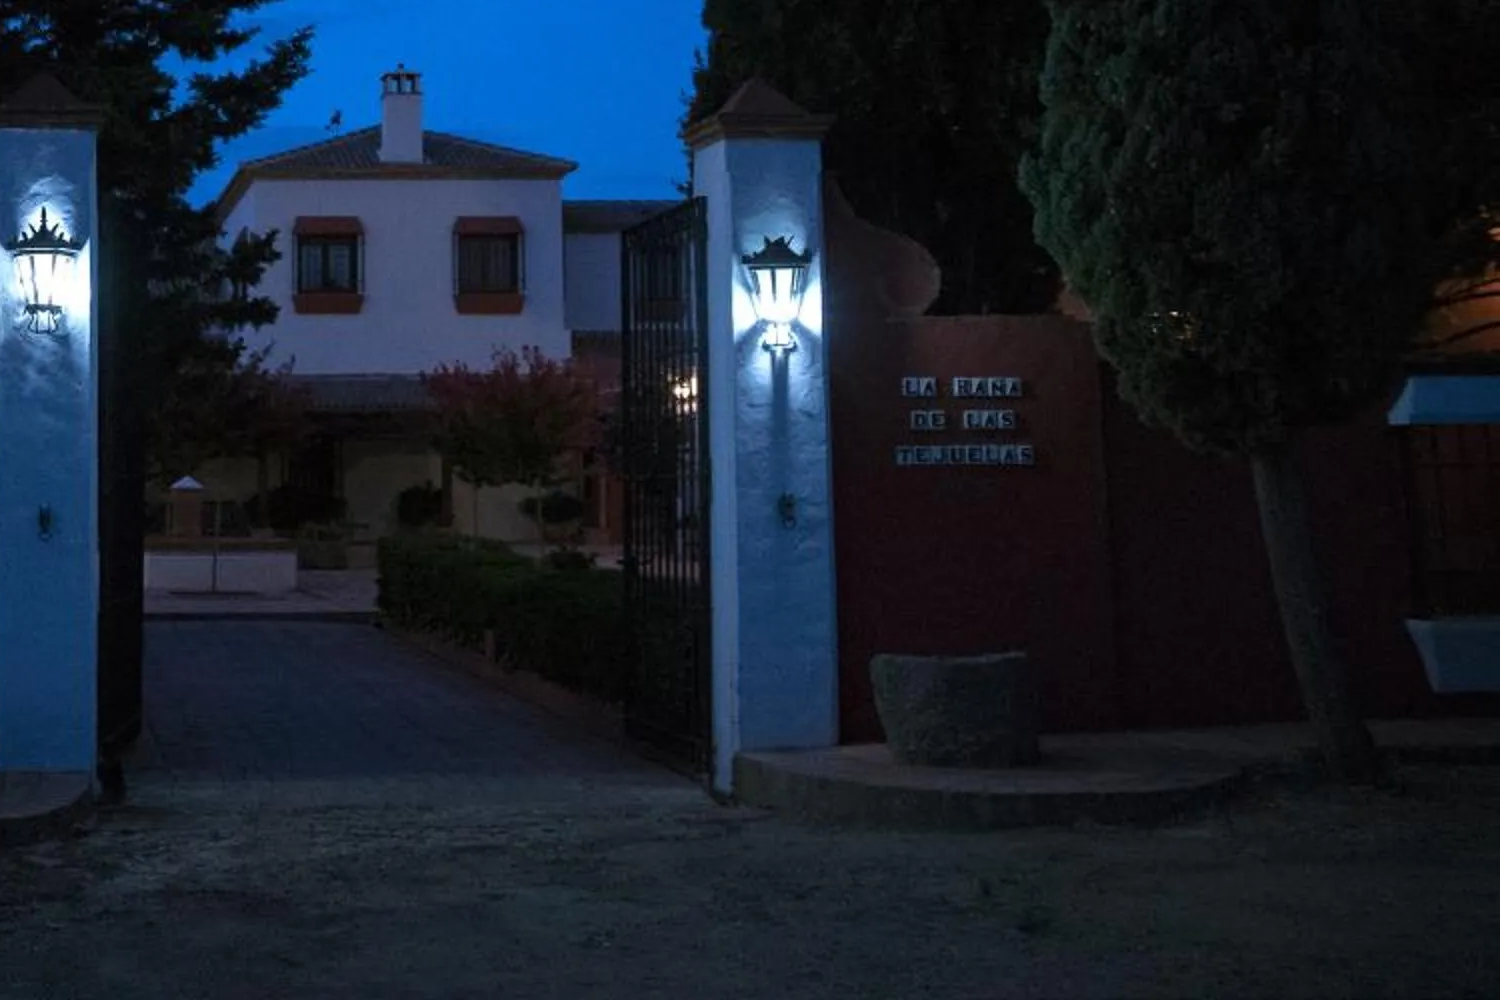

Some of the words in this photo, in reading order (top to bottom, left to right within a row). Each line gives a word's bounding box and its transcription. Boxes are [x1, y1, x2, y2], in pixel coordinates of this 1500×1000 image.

[904, 378, 935, 395] LA
[913, 410, 945, 428] DE
[965, 410, 1014, 428] LAS
